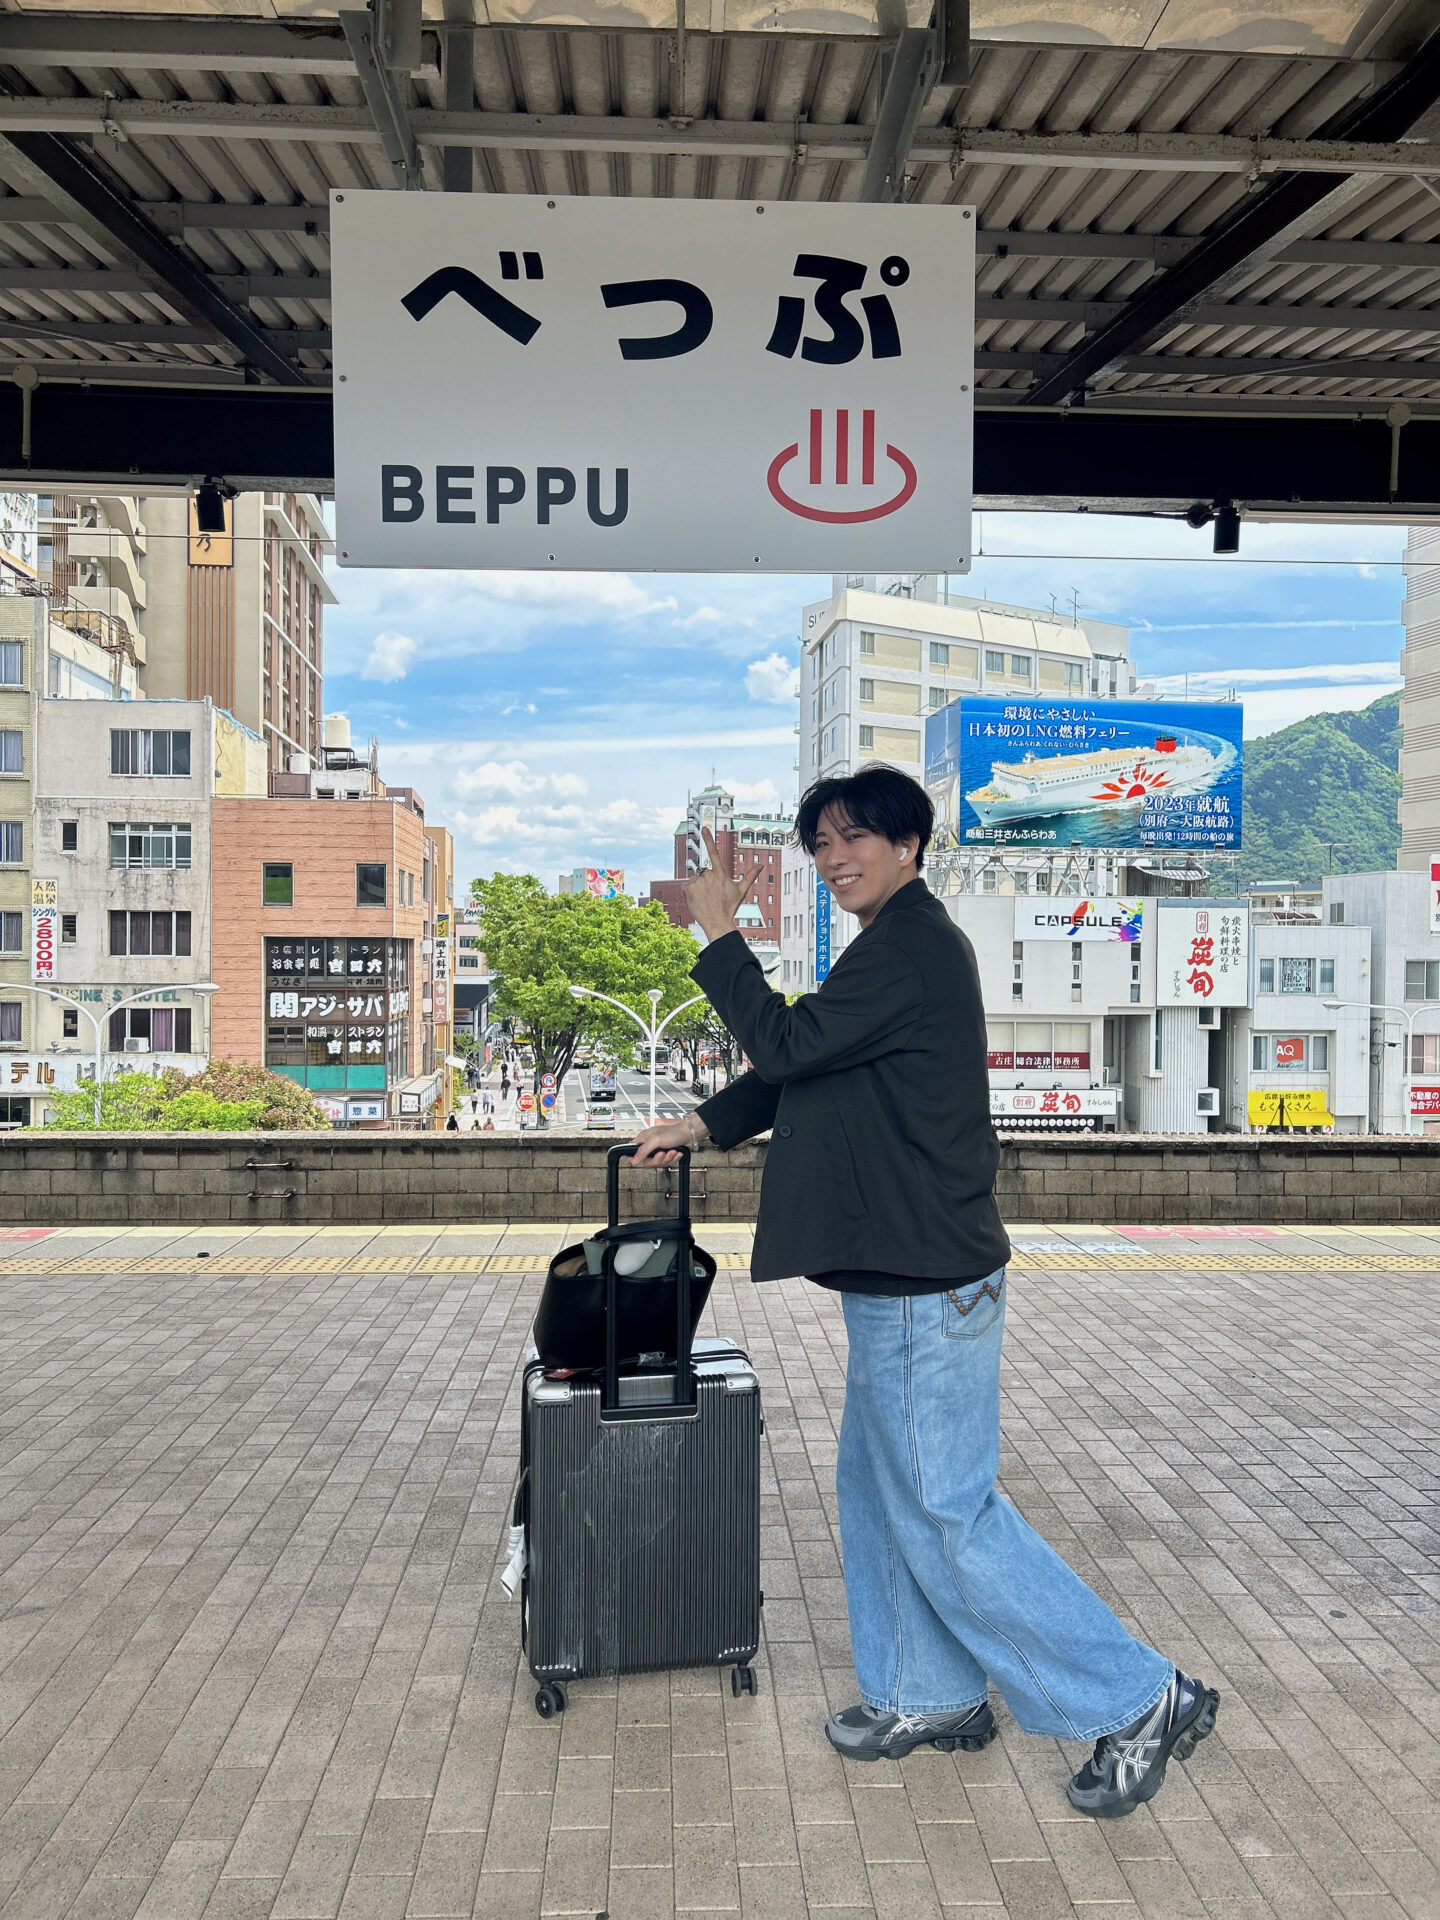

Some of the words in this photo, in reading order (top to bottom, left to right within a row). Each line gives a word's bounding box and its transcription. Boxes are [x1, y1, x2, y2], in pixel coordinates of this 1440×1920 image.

[401, 251, 910, 364] べっぷ
[381, 464, 629, 527] BEPPU
[1003, 706, 1096, 721] 環境にやさしい
[969, 722, 1130, 739] 日本初のLNG燃料フェリー
[1144, 796, 1230, 813] 2023年就航
[966, 829, 1056, 839] 商船三井さんふらわあ
[34, 881, 56, 892] 天然
[32, 907, 57, 918] シングル
[1035, 915, 1122, 926] CAPSULE
[819, 889, 828, 972] ステーションホテル
[36, 918, 53, 970] 2800円
[1220, 915, 1229, 973] 旬鮮料理の店
[1231, 916, 1241, 966] 炭火串焼と
[436, 940, 446, 978] 郷土料理
[271, 977, 301, 986] うなぎ
[270, 992, 383, 1018] 関アジ・サバ
[1277, 1045, 1295, 1056] AQ
[0, 1062, 55, 1083] テル
[352, 1106, 378, 1116] 惣菜
[1260, 1102, 1313, 1112] もくくさん
